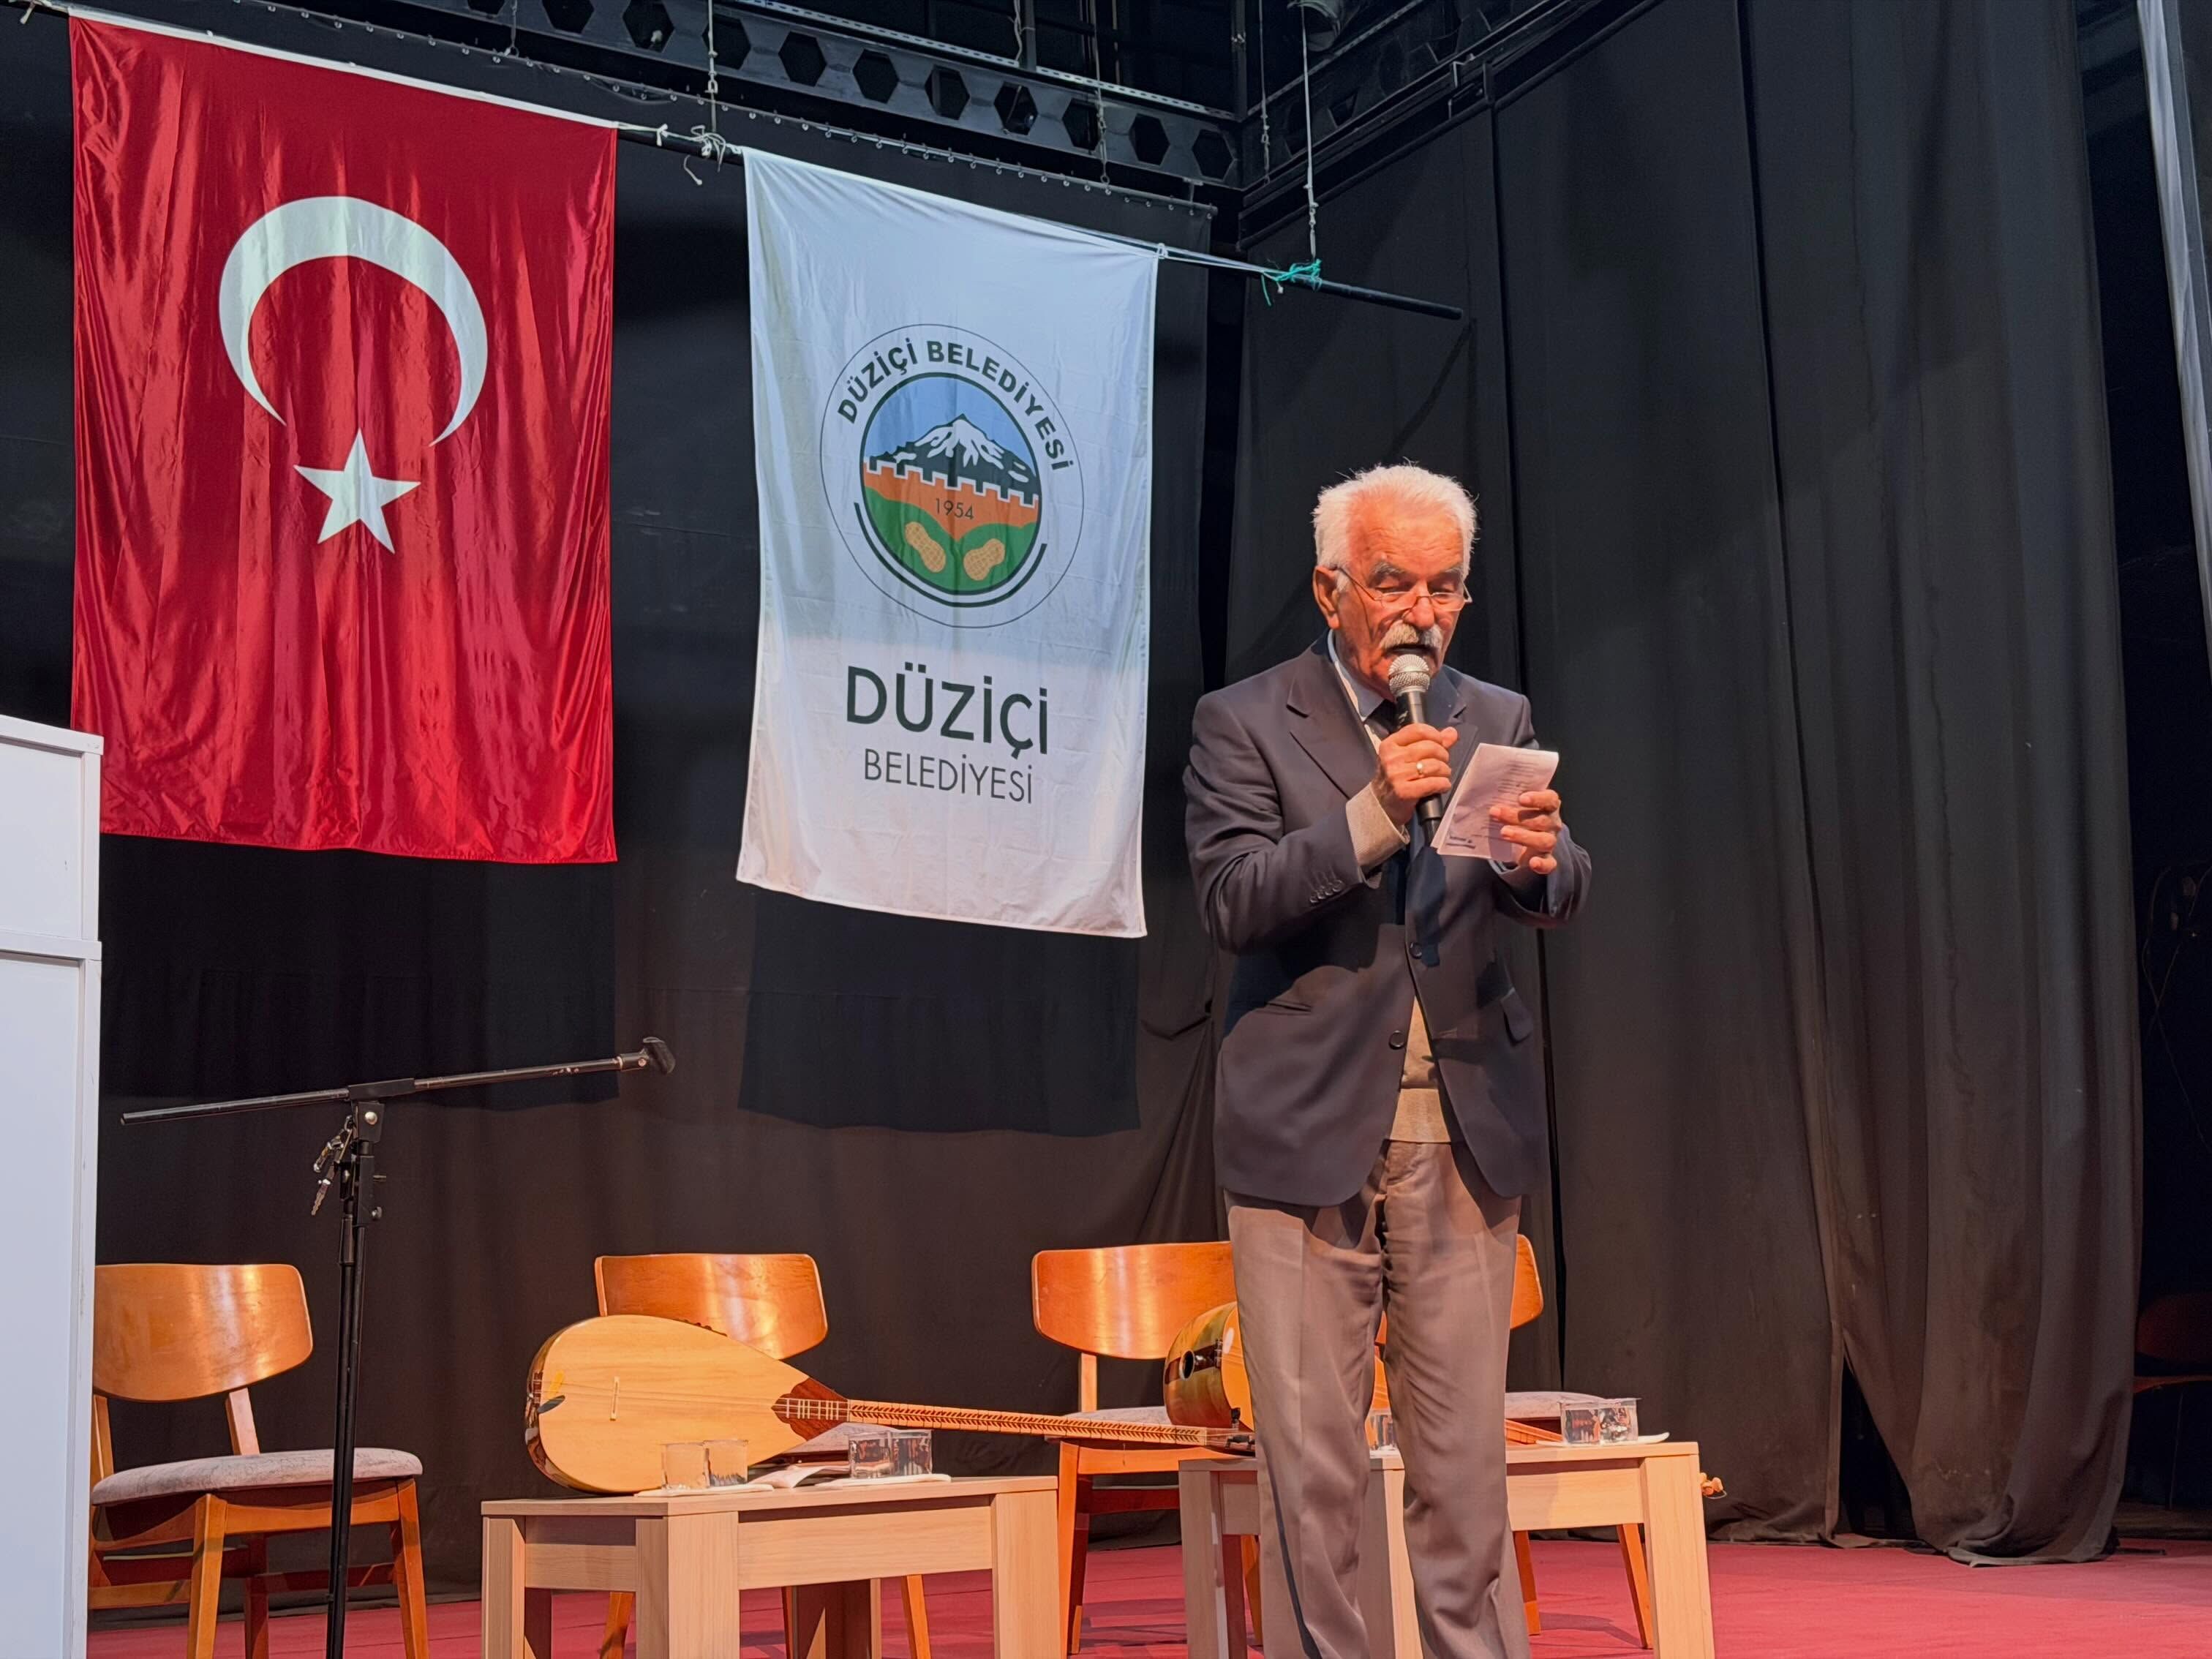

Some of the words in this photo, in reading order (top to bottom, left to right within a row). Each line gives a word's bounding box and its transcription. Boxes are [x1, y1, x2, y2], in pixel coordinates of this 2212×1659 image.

[838, 337, 917, 424] DÜZİÇİ
[926, 341, 1075, 470] BELEDİYESİ
[936, 498, 974, 520] 1954
[846, 661, 1047, 760] DÜZİÇİ
[865, 748, 1033, 804] BELEDİYESİ
